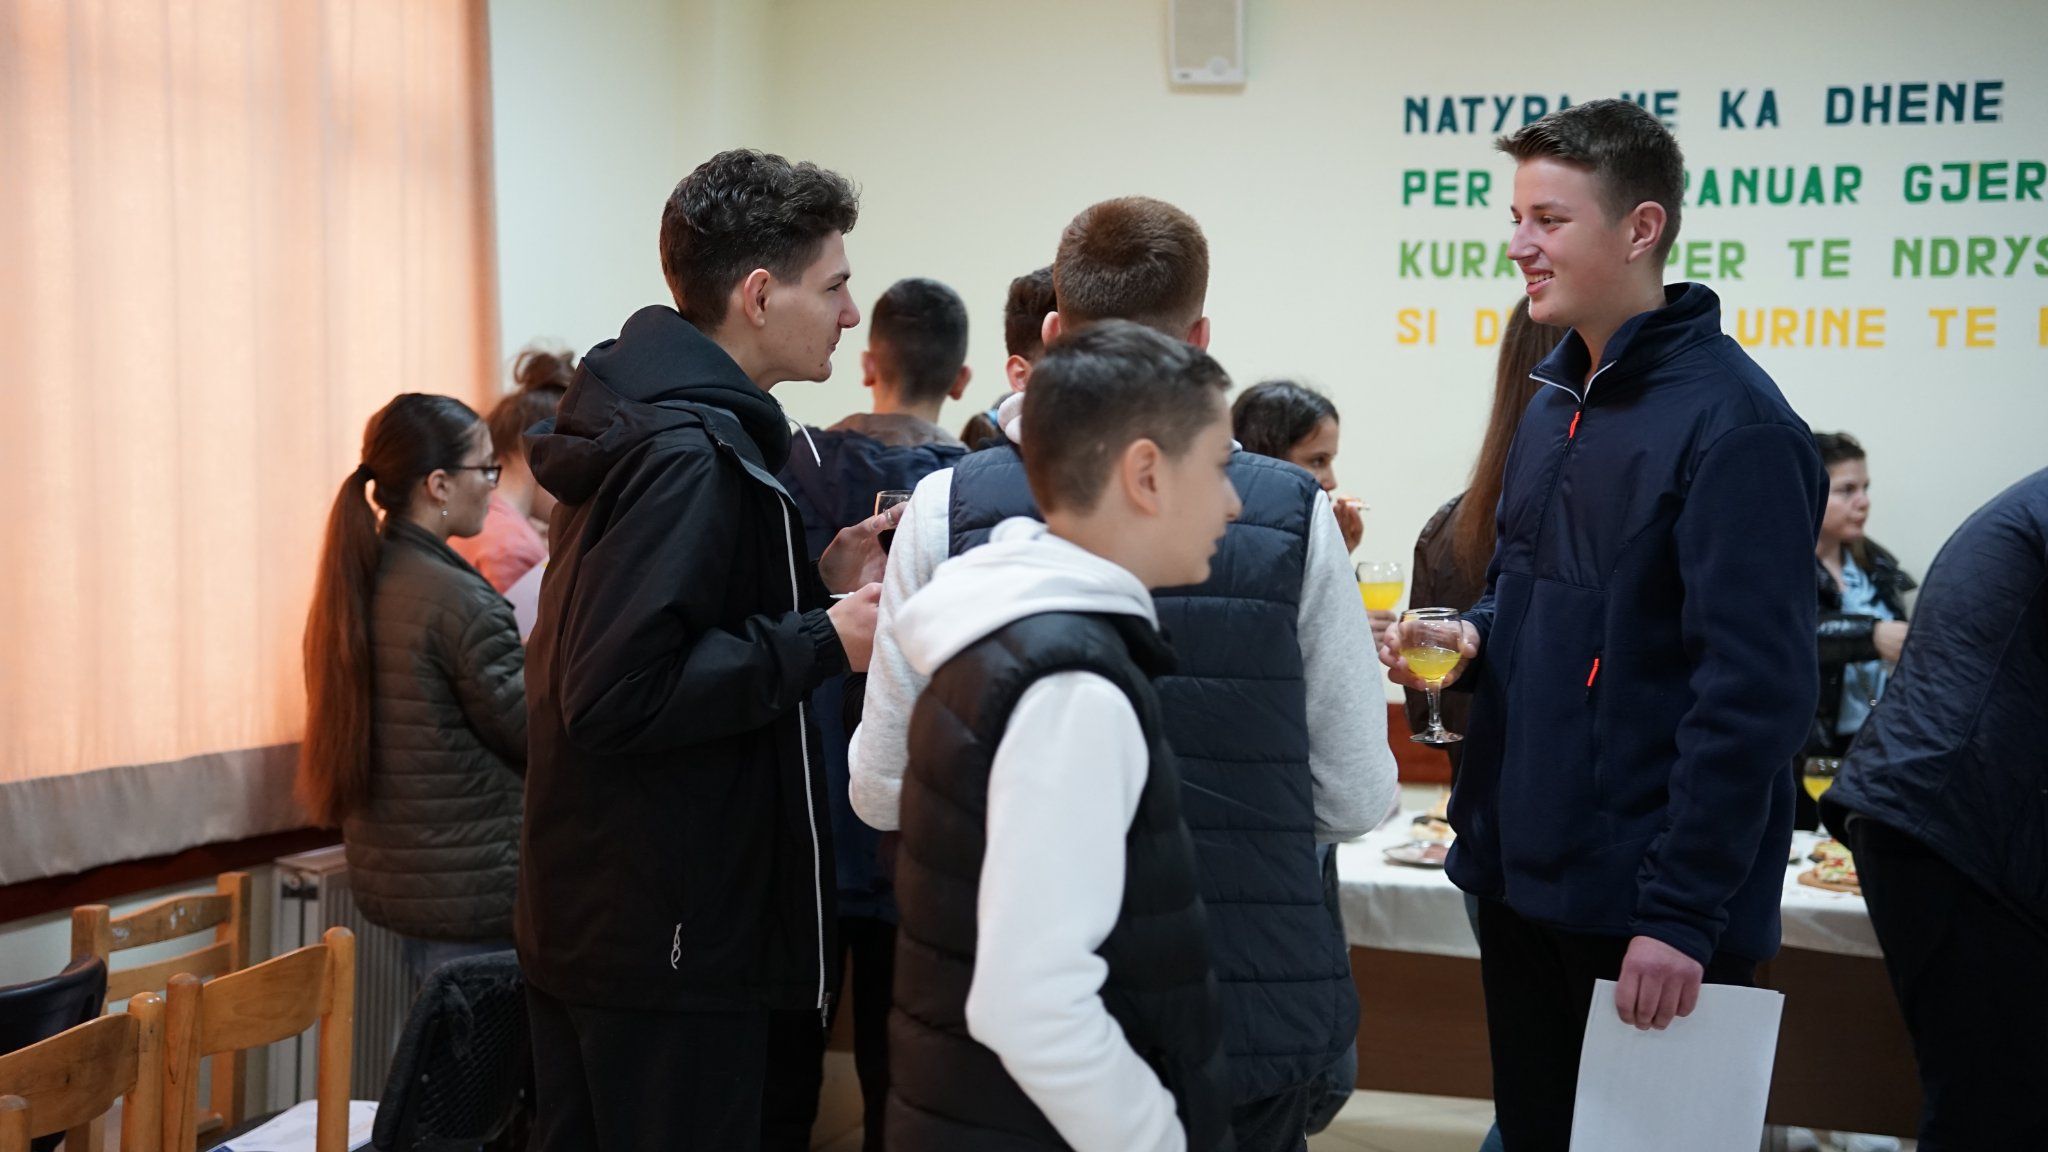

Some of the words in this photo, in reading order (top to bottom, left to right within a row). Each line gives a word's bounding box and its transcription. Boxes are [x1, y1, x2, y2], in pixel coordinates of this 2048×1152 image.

[1720, 89, 1779, 128] KA
[1826, 81, 2004, 124] DHENE
[1403, 170, 1491, 206] PER
[1904, 162, 2047, 202] GJER
[1400, 240, 1516, 279] KURA
[1788, 240, 1850, 278] TE
[1397, 308, 1436, 345] SI
[1736, 308, 1886, 347] URINE
[1929, 307, 1997, 347] TE
